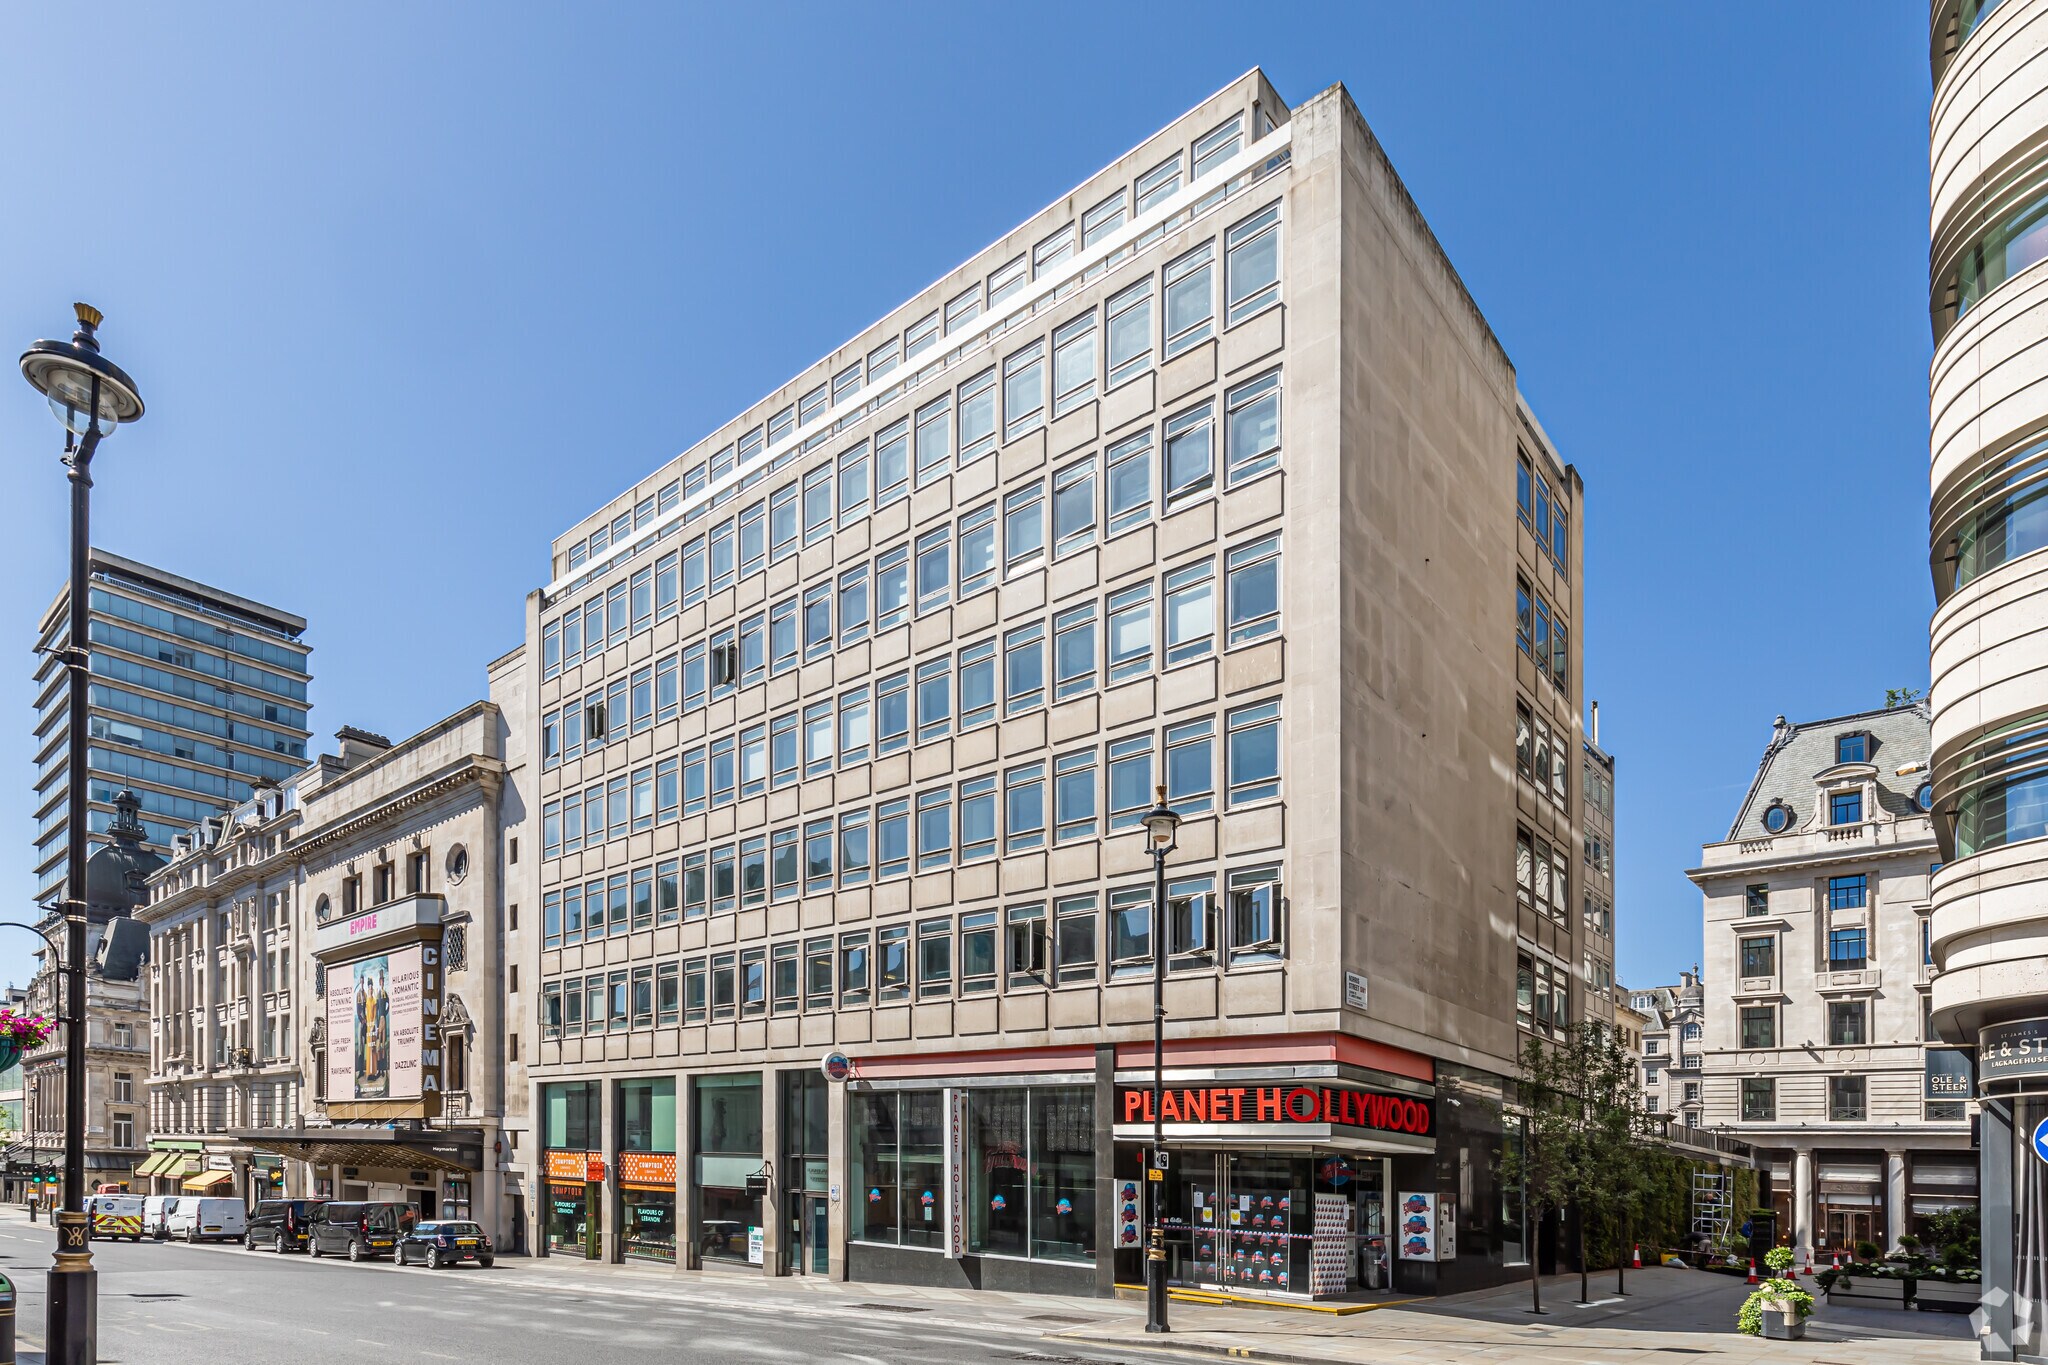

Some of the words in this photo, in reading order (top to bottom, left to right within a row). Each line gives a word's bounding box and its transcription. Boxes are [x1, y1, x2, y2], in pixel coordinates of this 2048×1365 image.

[350, 914, 377, 935] EMPIRE
[392, 971, 419, 984] HILARIOUS
[394, 982, 419, 994] ROMANTIC
[330, 997, 351, 1007] STUNNING
[423, 948, 439, 1091] CINEMA
[400, 1027, 419, 1035] ABSOLUTE
[2000, 1041, 2012, 1057] &
[1931, 1076, 1952, 1084] OLE
[1125, 1087, 1246, 1122] PLANET
[1257, 1087, 1430, 1134] HOLLYWOOD
[551, 1186, 583, 1196] COMPTOIR
[953, 1163, 961, 1254] HOLLYWOOD
